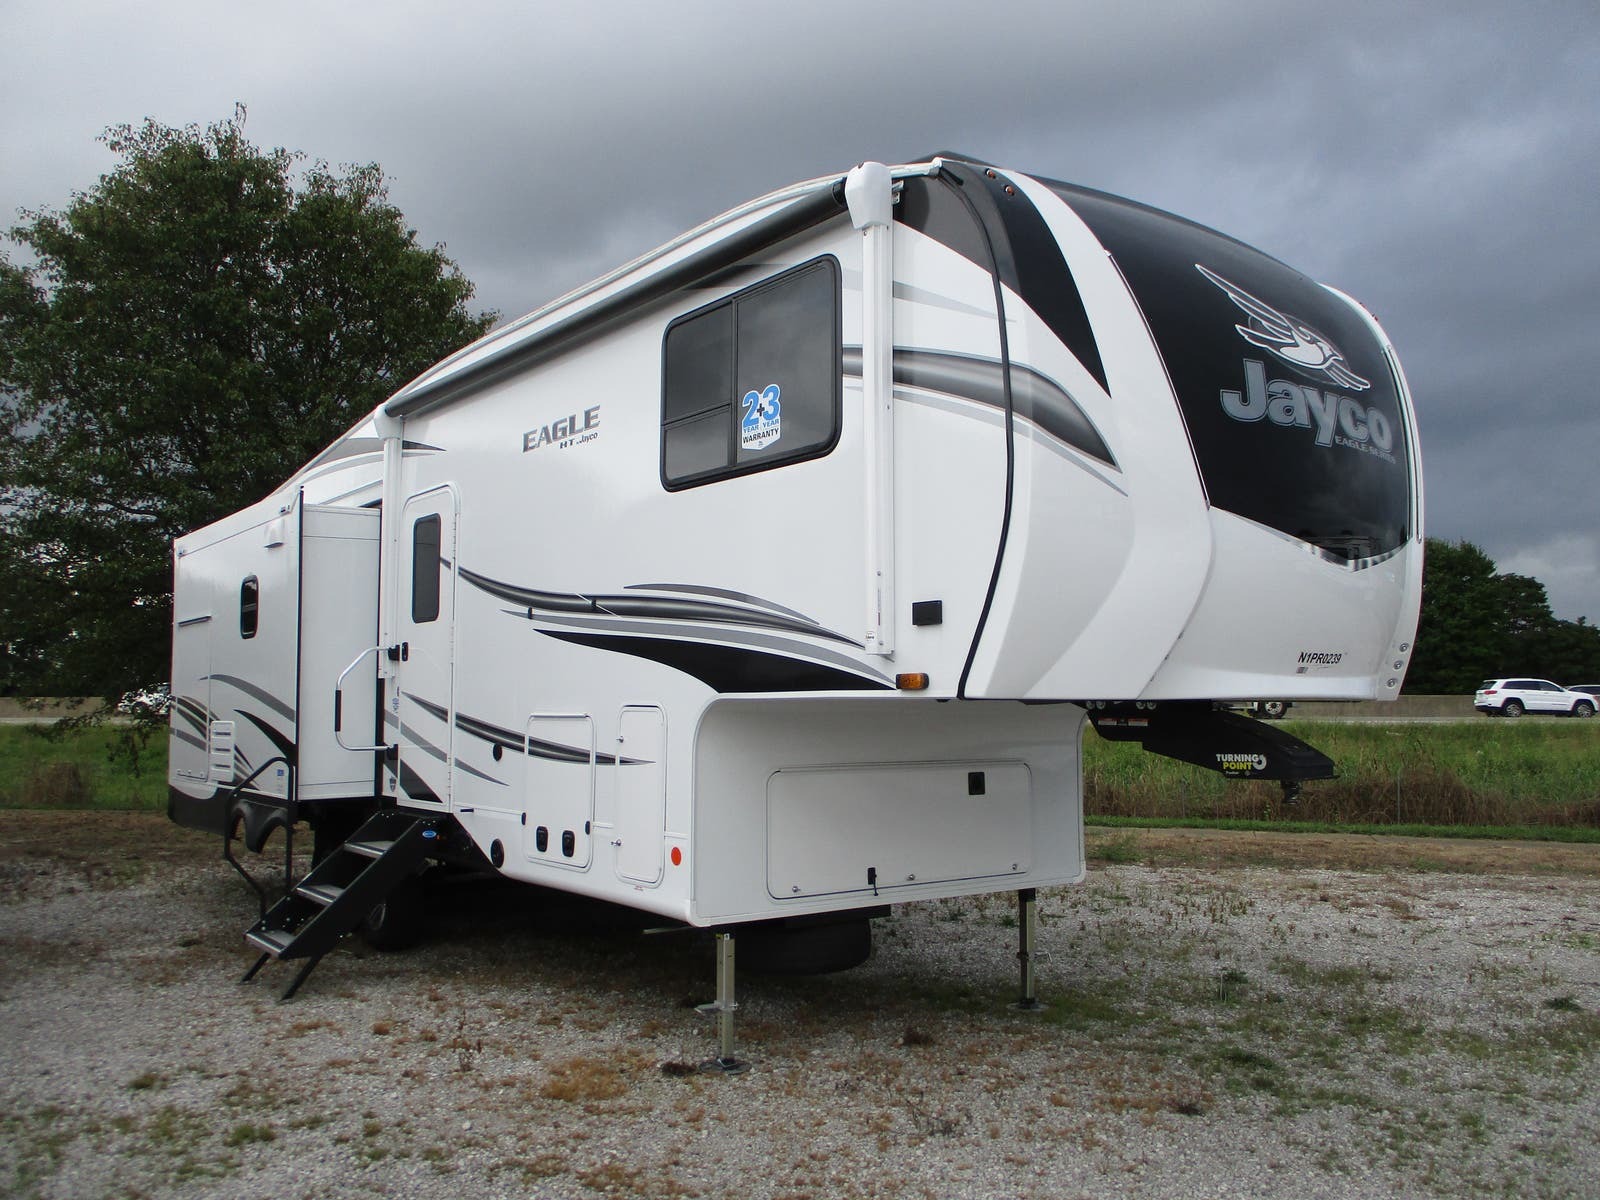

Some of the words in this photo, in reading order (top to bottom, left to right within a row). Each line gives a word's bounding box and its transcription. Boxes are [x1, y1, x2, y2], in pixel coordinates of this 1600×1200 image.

[1220, 358, 1393, 452] Jayco
[522, 404, 600, 453] EAGLE
[763, 419, 779, 428] YEAR
[743, 427, 779, 444] WARRANTY
[559, 438, 576, 449] HT
[1297, 651, 1342, 665] N1PR0239
[1215, 753, 1259, 762] TURNING
[1223, 762, 1253, 770] POINT
